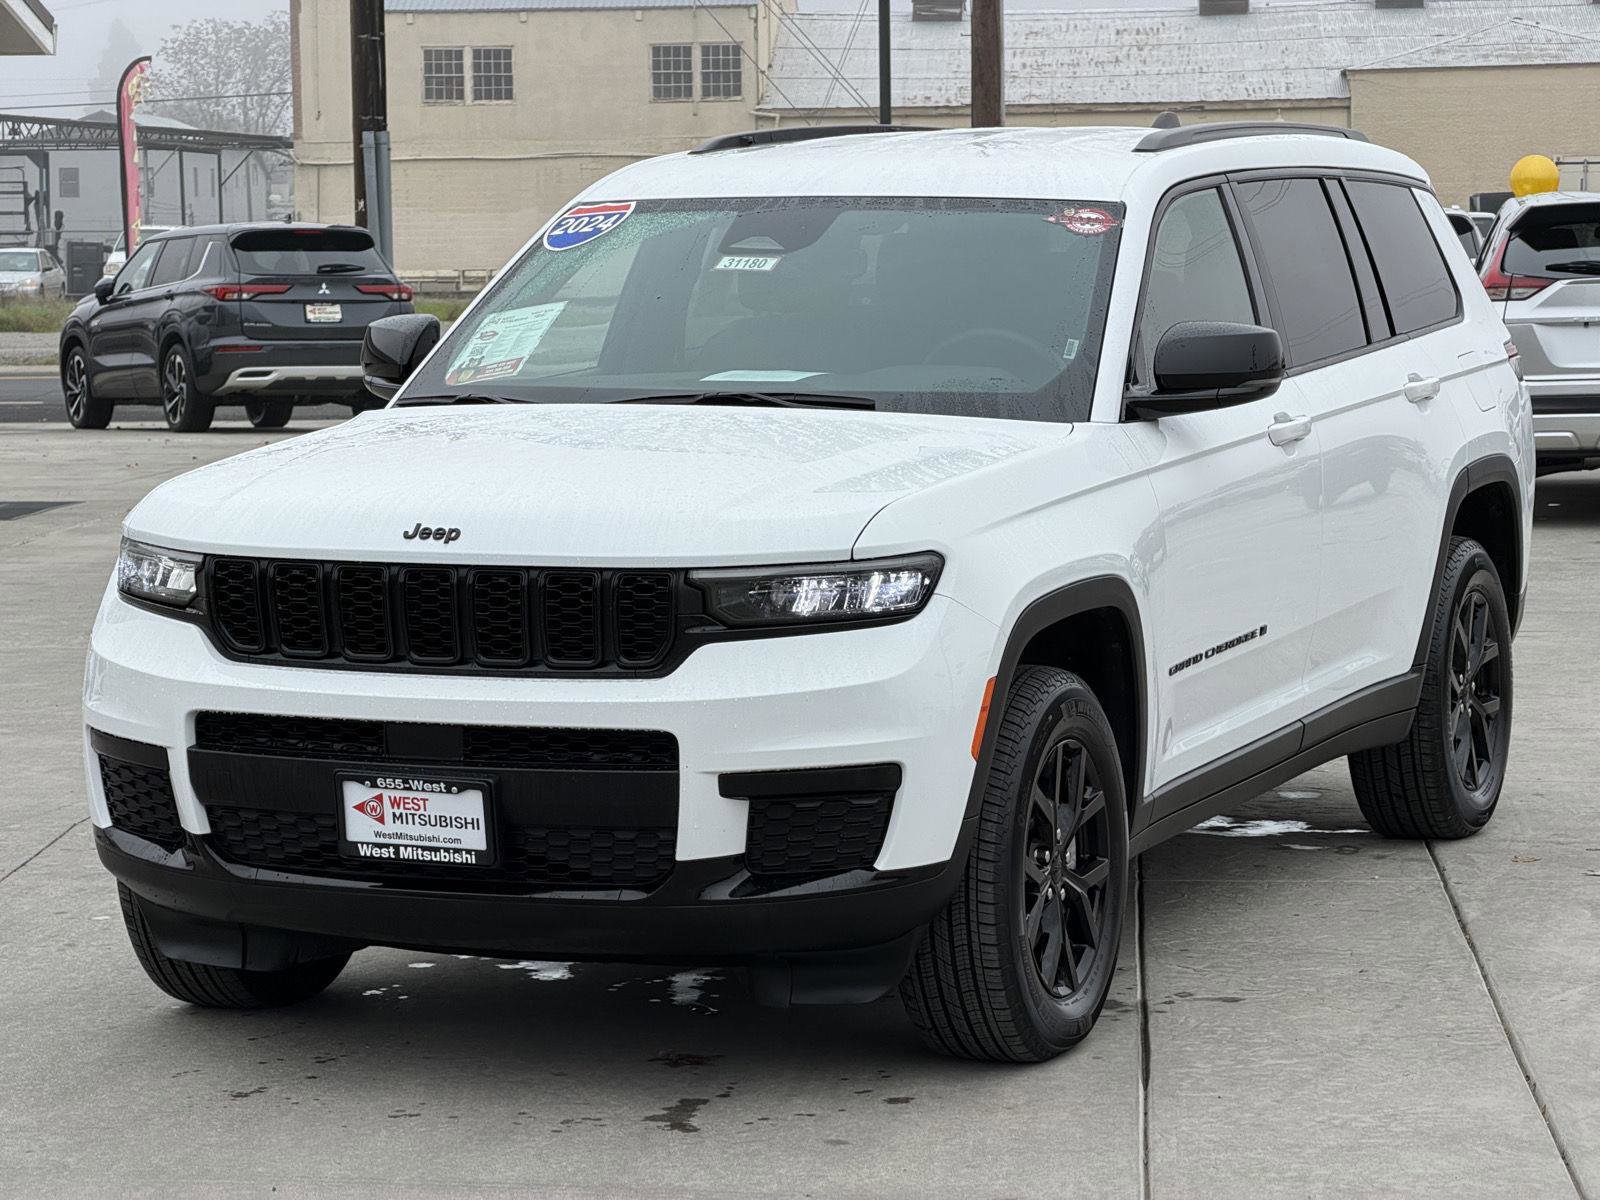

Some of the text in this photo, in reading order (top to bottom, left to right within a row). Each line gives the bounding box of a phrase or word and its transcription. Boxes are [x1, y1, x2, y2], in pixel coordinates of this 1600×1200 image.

[548, 214, 621, 235] 2024
[723, 258, 768, 268] 31180
[403, 523, 461, 544] Jeep
[376, 777, 447, 793] 655-West
[368, 803, 379, 815] W
[388, 795, 429, 812] WEST
[392, 811, 481, 831] MITSUBISHI
[373, 830, 462, 845] WestMitsubishi.com
[357, 843, 476, 864] West Mitsubishi
